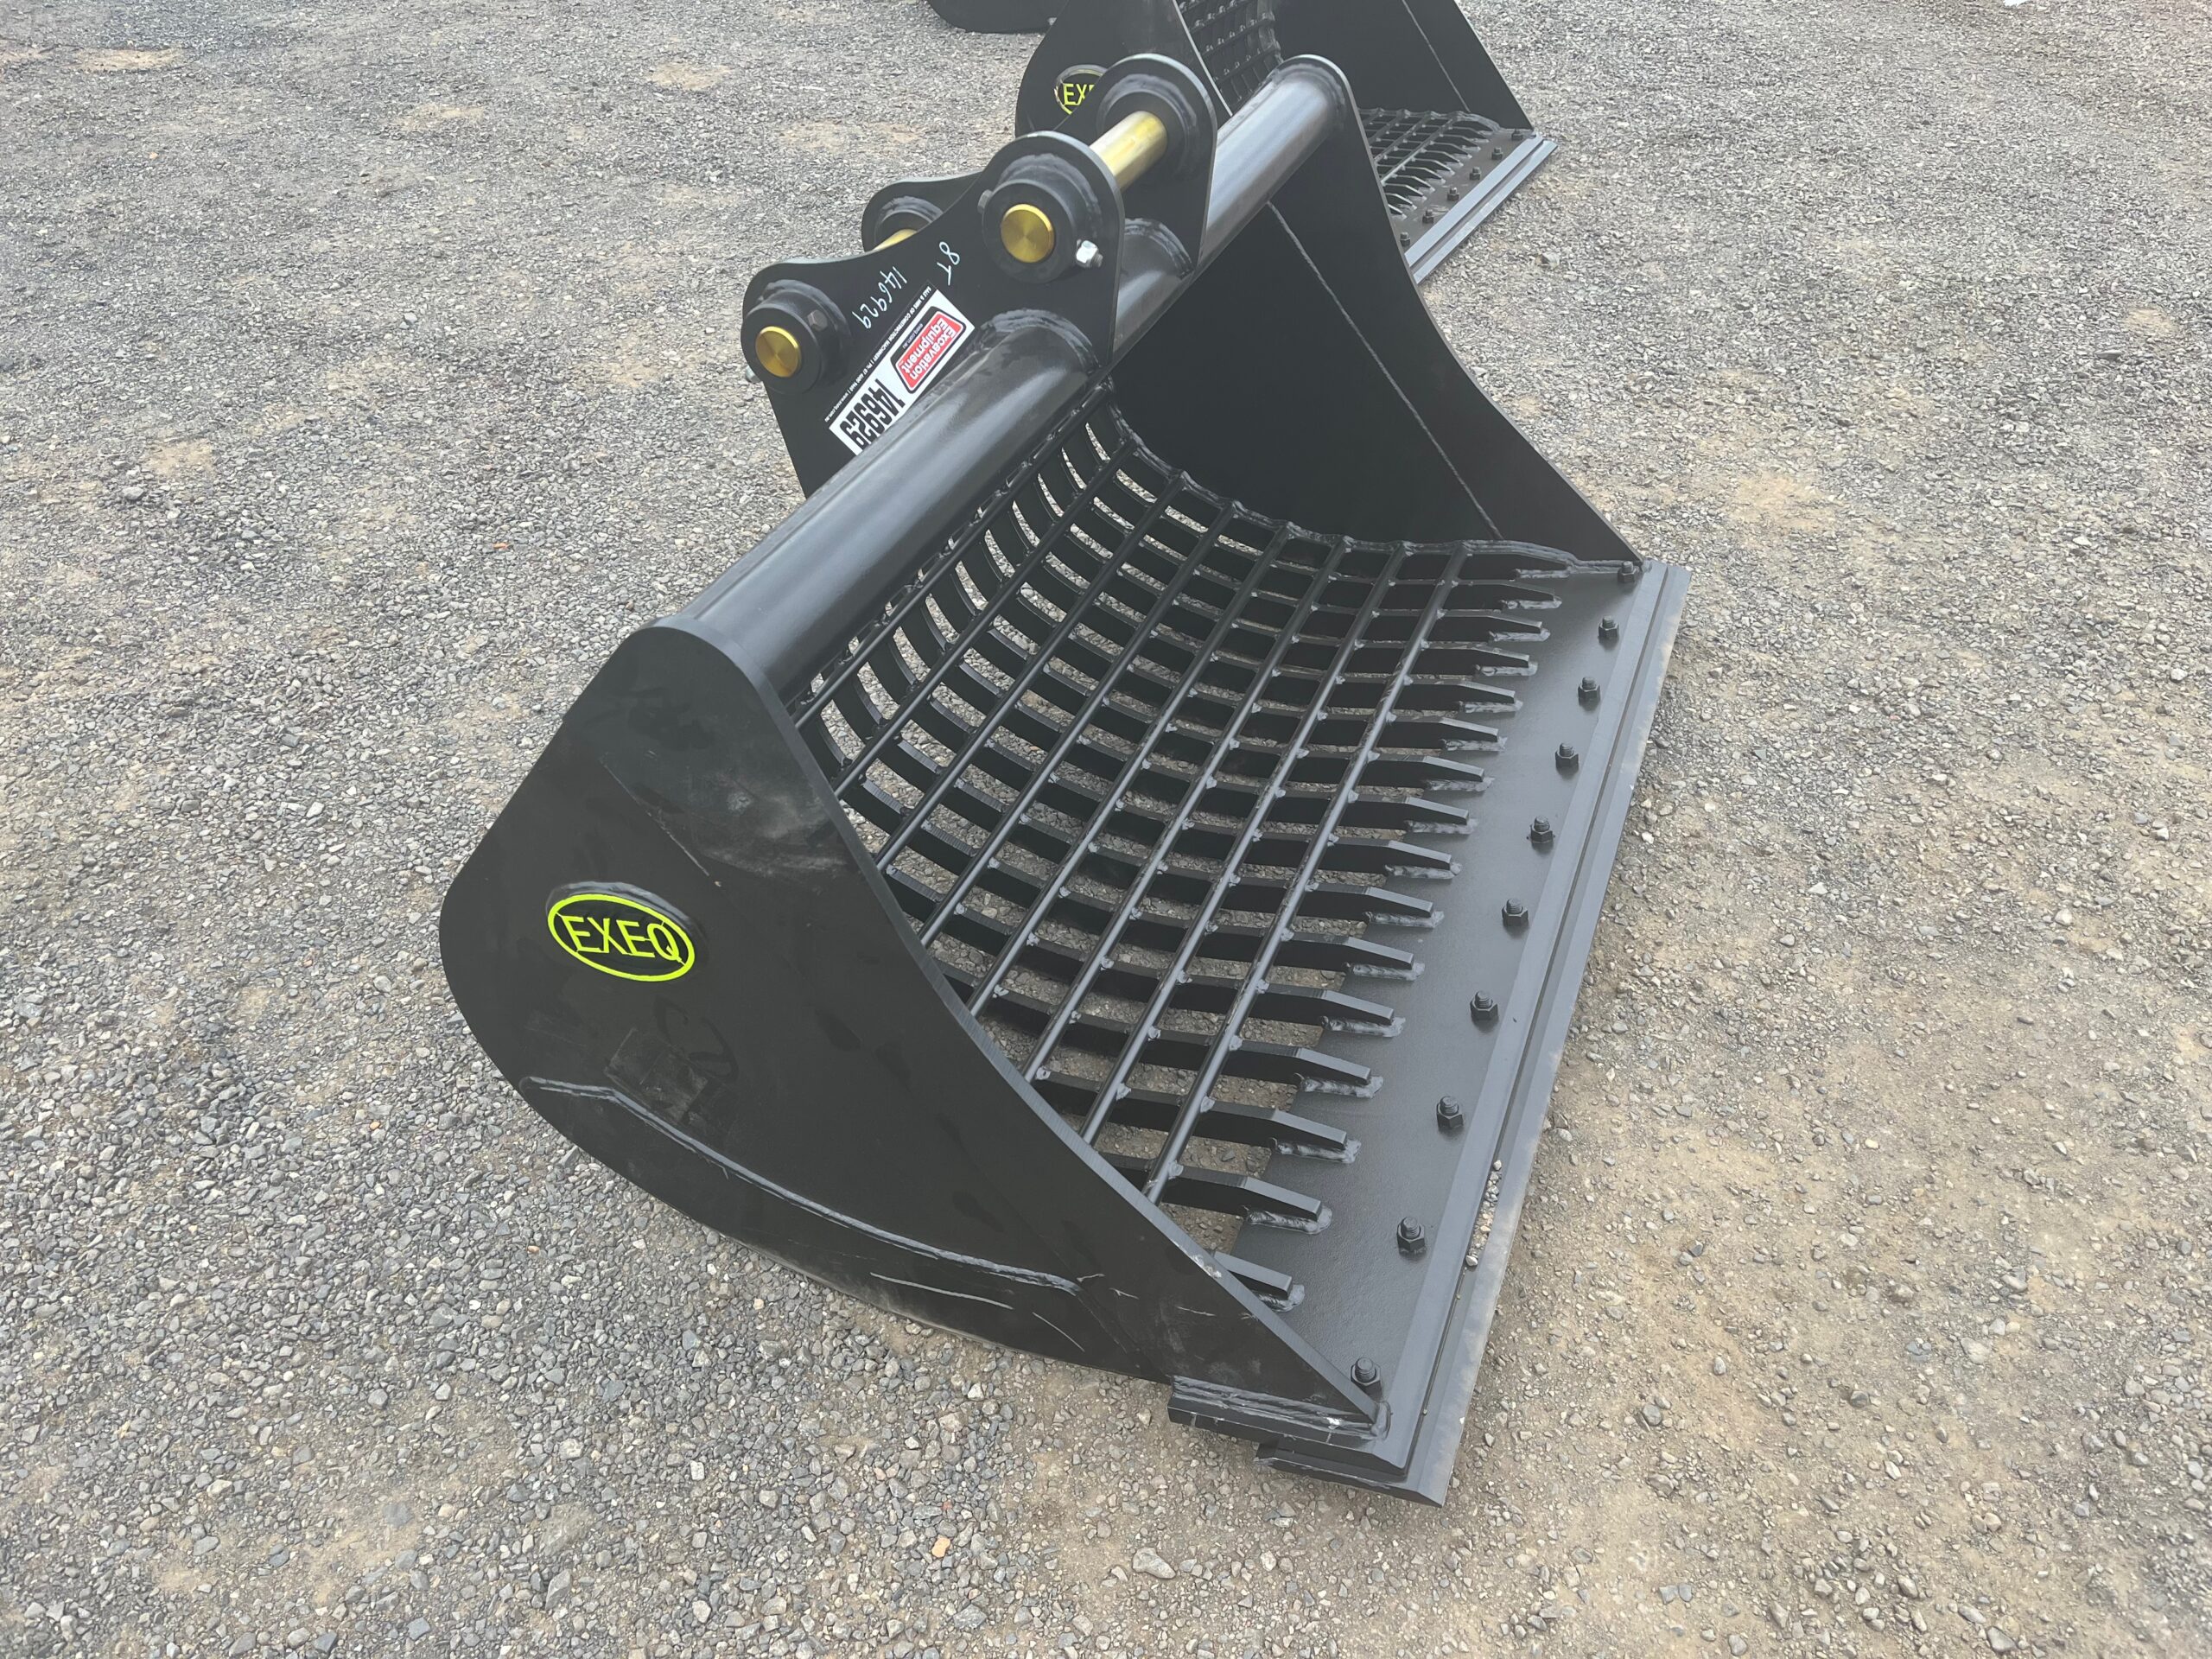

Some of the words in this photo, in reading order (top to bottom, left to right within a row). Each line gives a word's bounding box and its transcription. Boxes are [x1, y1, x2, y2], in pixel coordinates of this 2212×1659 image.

[1063, 83, 1095, 105] EX
[937, 241, 961, 286] 8T
[852, 265, 907, 329] 146929
[873, 340, 890, 361] MACHINERY
[888, 312, 911, 342] CONSTRUCTION
[900, 317, 948, 373] Equipment
[909, 324, 957, 381] Excavation
[840, 378, 905, 449] 146929
[562, 915, 683, 963] EXEQ
